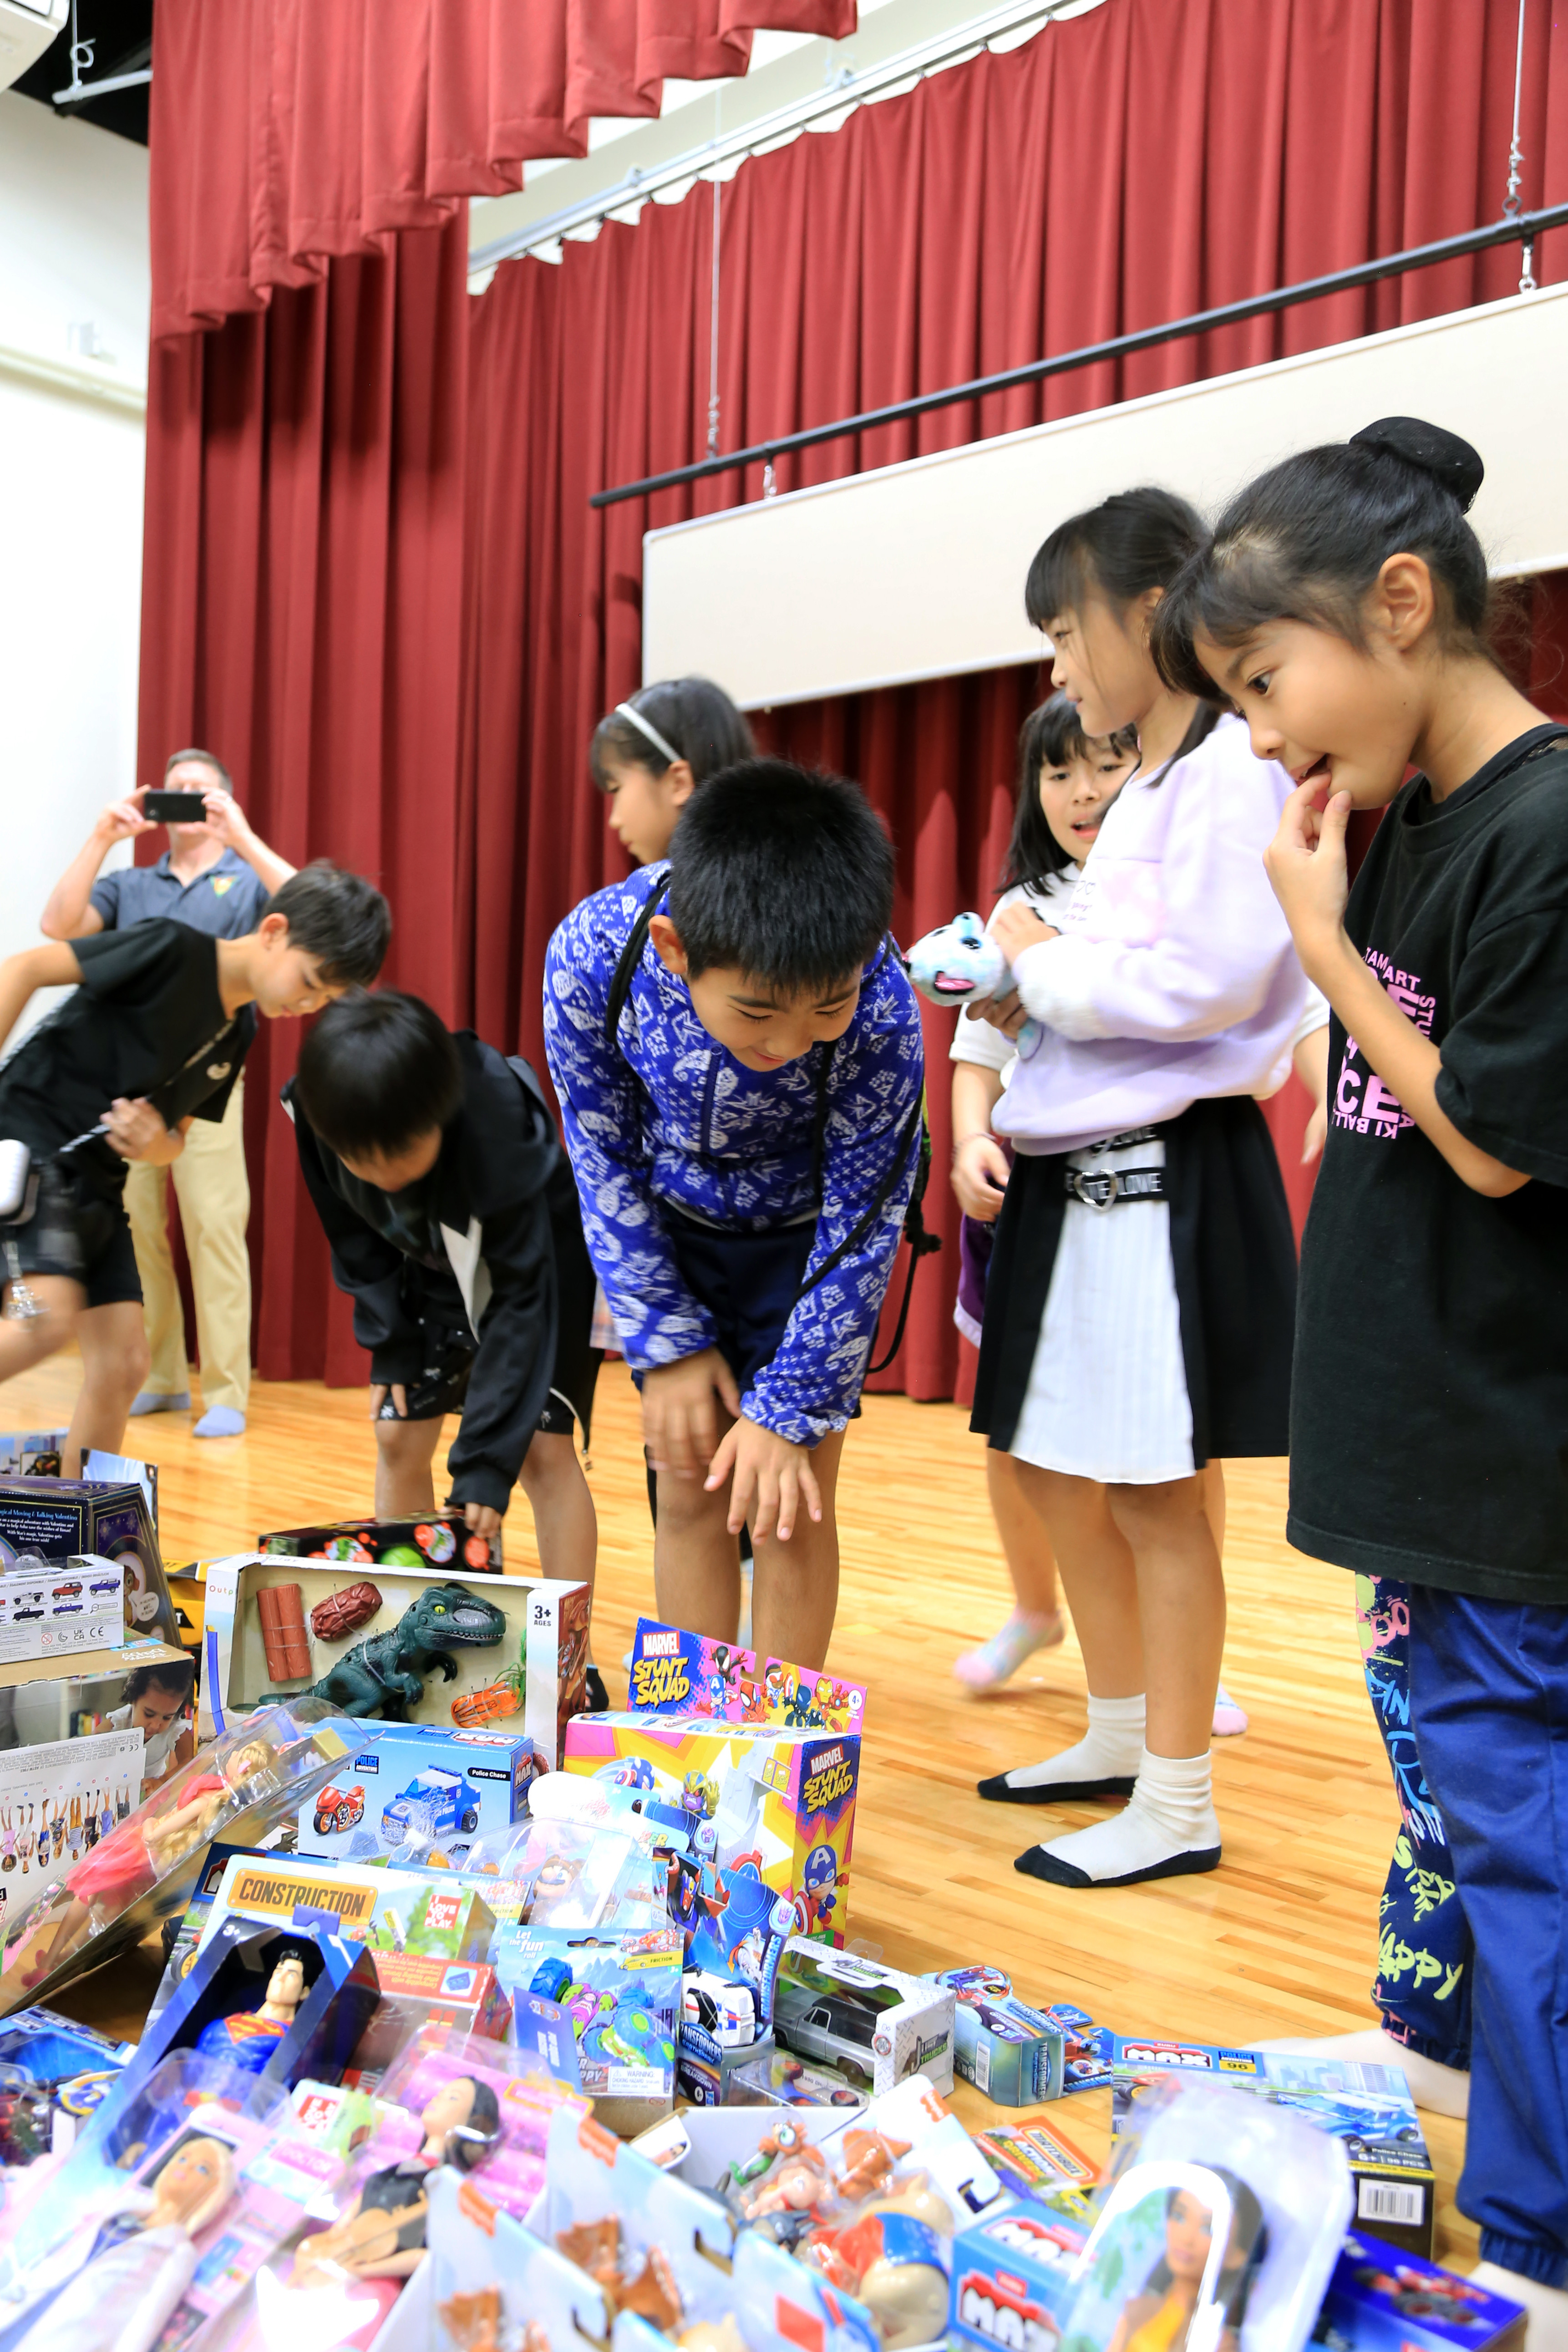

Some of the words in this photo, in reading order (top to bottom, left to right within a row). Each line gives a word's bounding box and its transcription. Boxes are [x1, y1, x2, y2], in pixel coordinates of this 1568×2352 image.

[1383, 965, 1421, 991] ART
[13, 1509, 31, 1519] Moving
[37, 1511, 54, 1520] Talking
[55, 1513, 77, 1521] Valentino
[534, 1605, 551, 1619] 3+
[643, 1633, 679, 1656] MARVEL
[633, 1657, 689, 1683] STUNT
[635, 1676, 690, 1708] SQUAD
[852, 1695, 860, 1703] 4+
[356, 1756, 378, 1766] POLICE
[811, 1746, 843, 1775] MARVEL
[355, 1765, 378, 1773] ADVENTURE
[490, 1771, 507, 1779] Chase
[516, 1762, 531, 1786] MAX
[803, 1760, 852, 1799] STUNT
[807, 1774, 853, 1813] SQUAD
[442, 1804, 455, 1816] POLICE
[239, 1878, 367, 1917] CONSTRUCTION
[429, 1902, 457, 1914] LOVE
[431, 1911, 445, 1920] TO
[424, 1917, 452, 1929] PLAY
[223, 1925, 240, 1936] 3+
[516, 1930, 532, 1939] Let
[519, 1938, 545, 1952] fun
[626, 1945, 640, 1953] FLIP
[759, 1934, 782, 2019] TRANSFORMERS
[405, 1980, 437, 1989] Compatible
[921, 2041, 948, 2064] TRUCKS
[1127, 2047, 1210, 2067] MAX
[1037, 2042, 1049, 2101] TRANSFORMERS
[1227, 2062, 1248, 2070] 96
[681, 2064, 713, 2090] BREAKDOWN
[1371, 2147, 1396, 2155] Police
[1397, 2150, 1423, 2159] Chase
